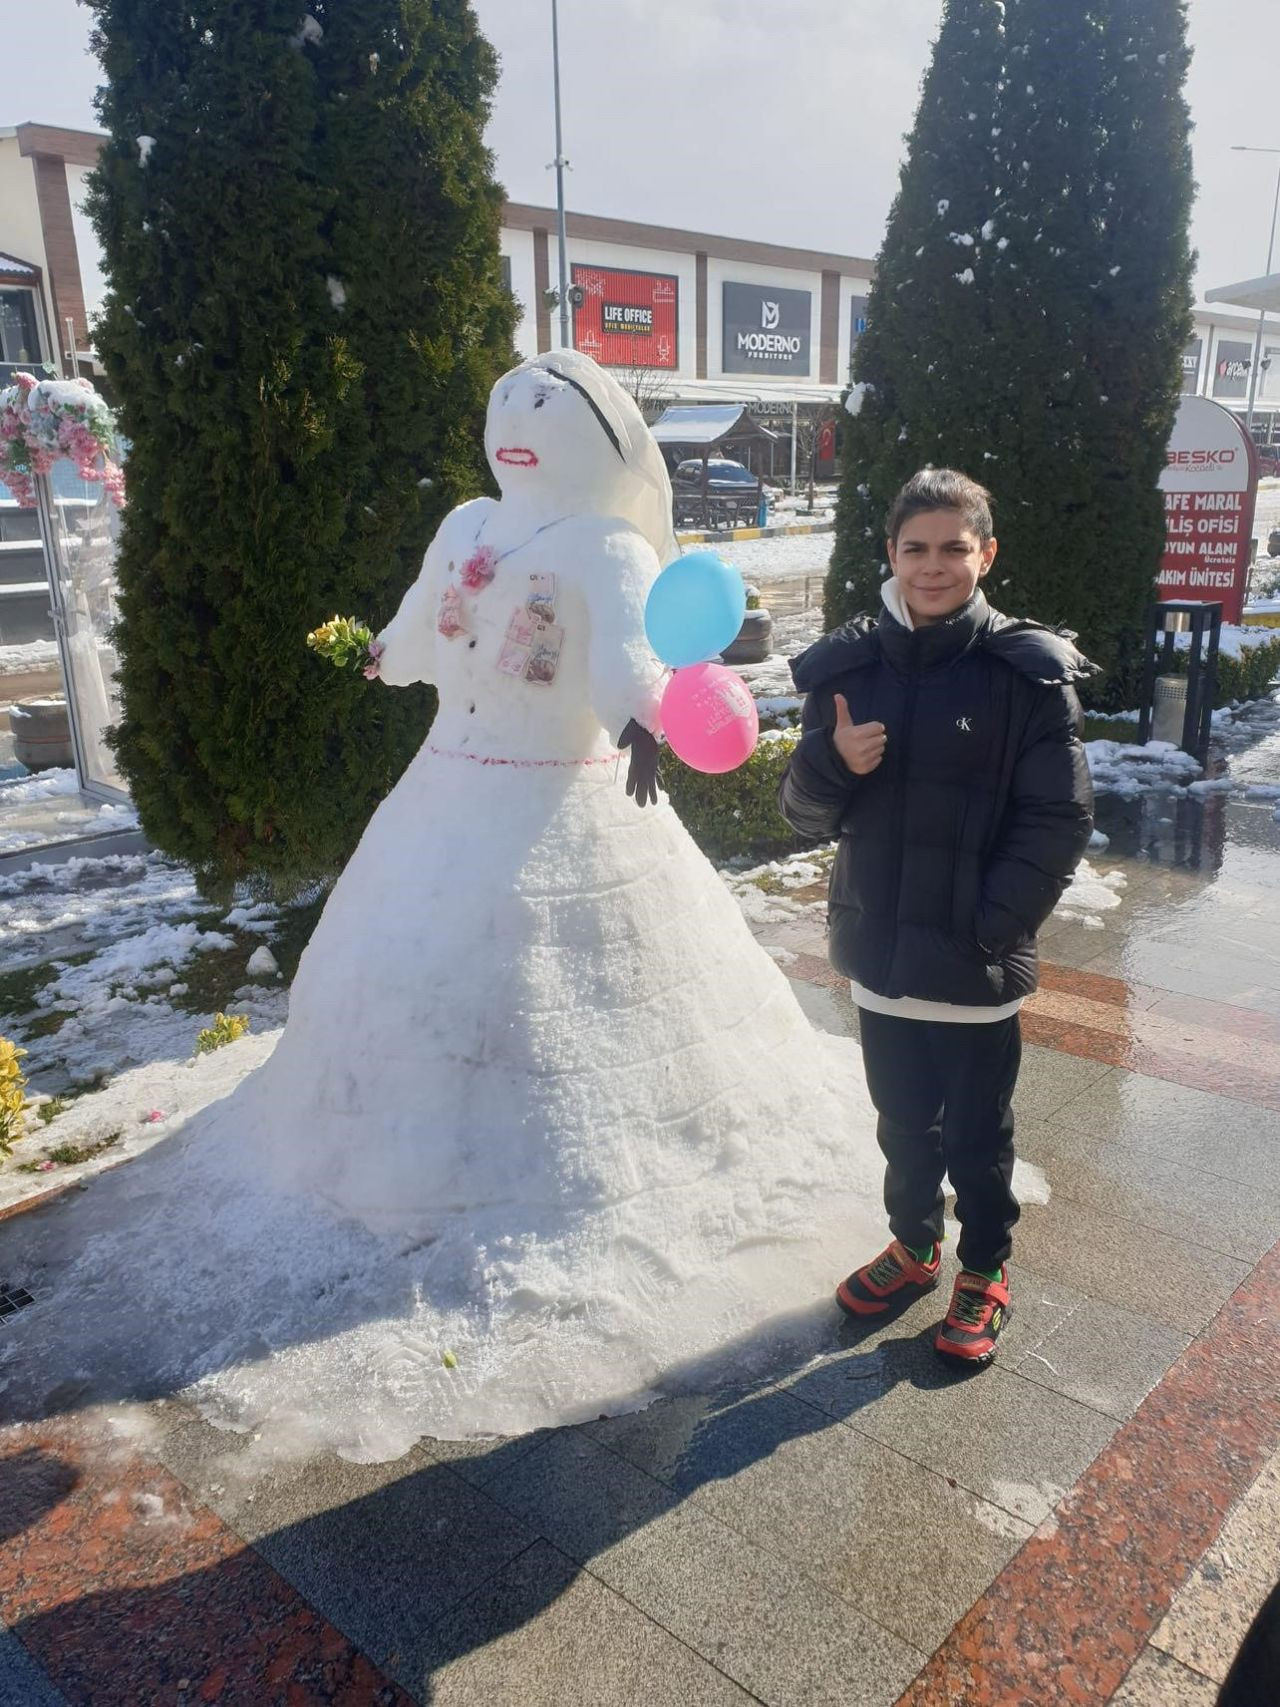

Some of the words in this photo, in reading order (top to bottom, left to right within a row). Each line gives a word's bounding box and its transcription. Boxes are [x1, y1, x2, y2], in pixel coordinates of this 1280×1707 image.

[604, 306, 623, 321] LIFE
[624, 308, 652, 324] OFFICE
[737, 332, 800, 353] MODERNO
[747, 351, 793, 360] FURNITURE
[1164, 493, 1191, 510] AFE
[1195, 494, 1242, 511] MARAL
[1197, 515, 1239, 533] OFİSİ
[1199, 542, 1238, 555] ALANI
[1154, 570, 1186, 586] AKIM
[1189, 567, 1235, 588] ÜNİTESİ
